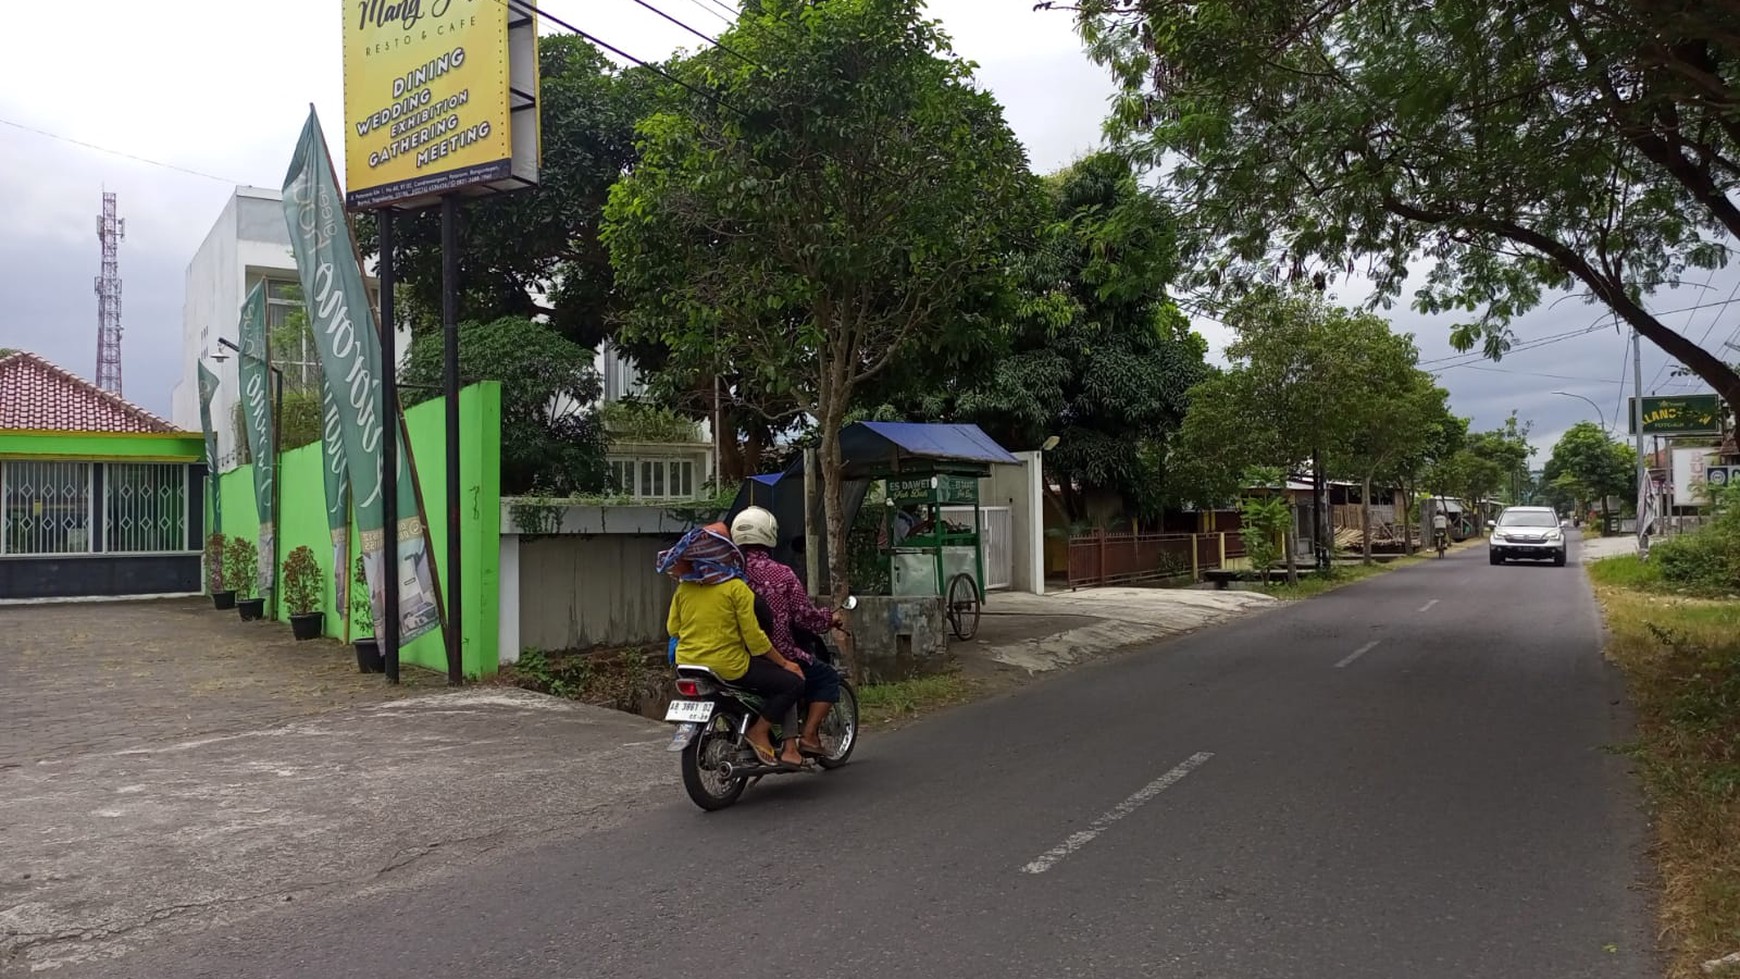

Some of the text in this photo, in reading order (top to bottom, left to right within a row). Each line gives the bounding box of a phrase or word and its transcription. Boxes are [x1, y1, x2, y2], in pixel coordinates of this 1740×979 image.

[366, 16, 476, 56] RESTO & CAFE
[392, 47, 465, 99] DINING
[356, 88, 431, 137] WEDDING
[390, 89, 469, 138] EXHIBITION
[369, 114, 458, 168] GATHERING
[416, 121, 491, 168] MEETING
[889, 479, 930, 491] ES DAWET
